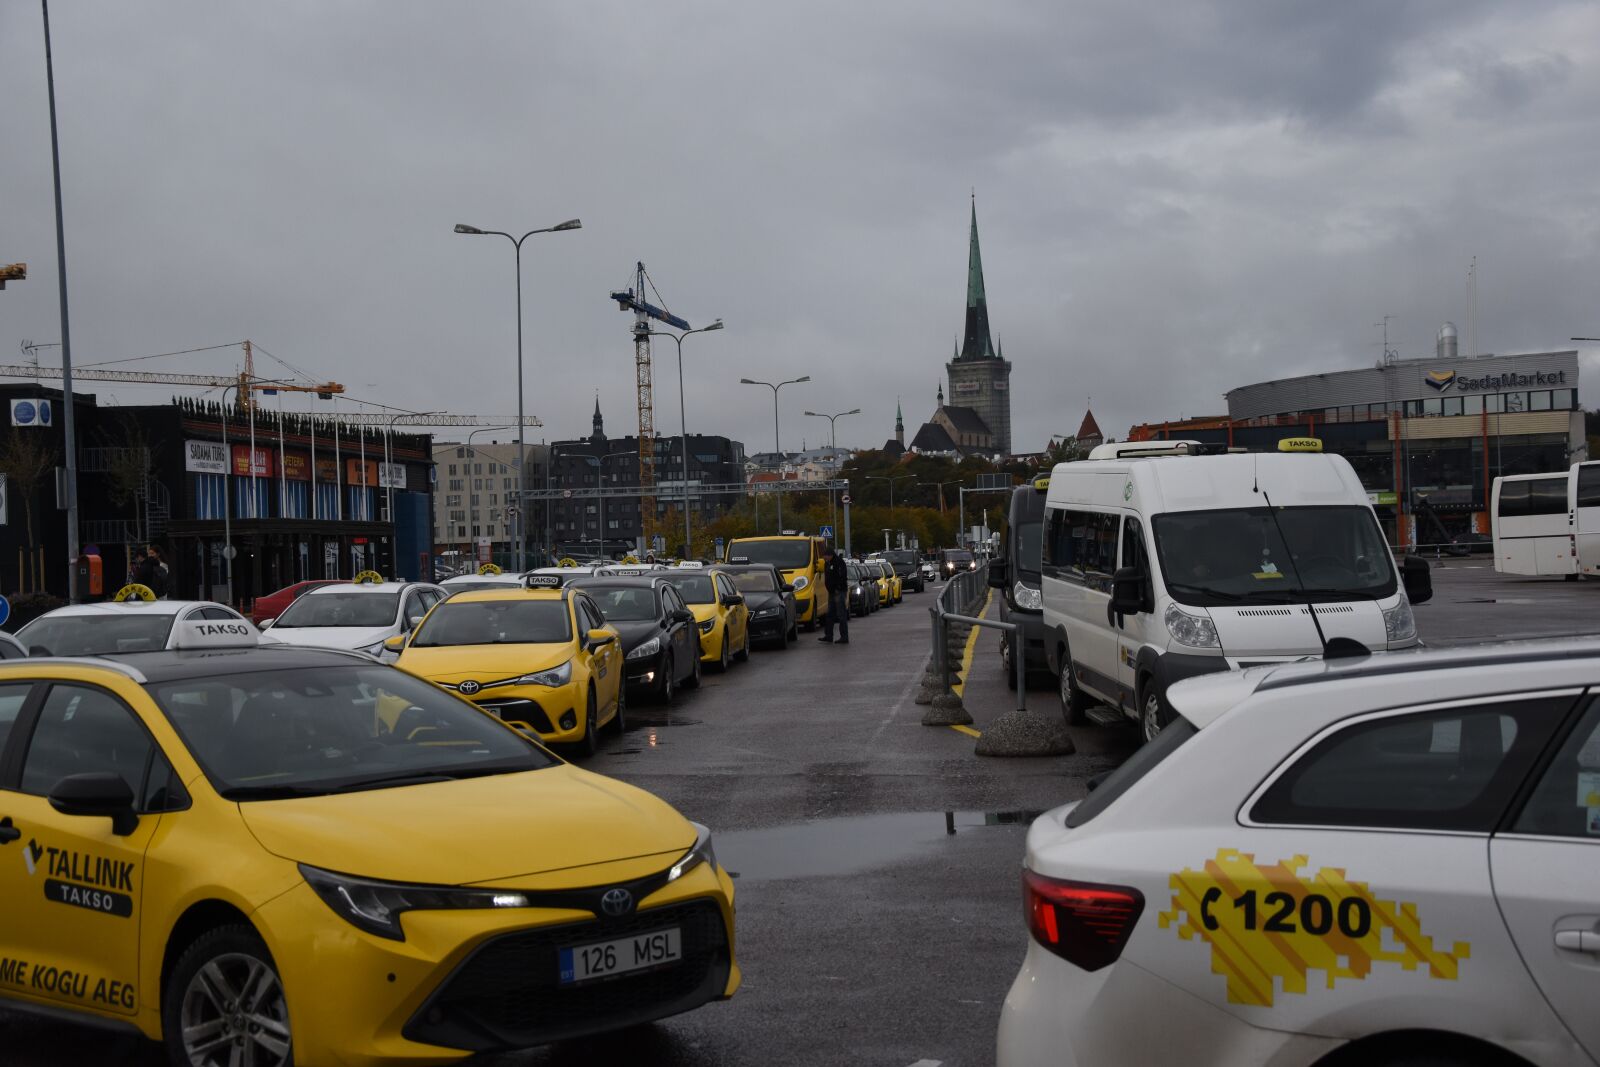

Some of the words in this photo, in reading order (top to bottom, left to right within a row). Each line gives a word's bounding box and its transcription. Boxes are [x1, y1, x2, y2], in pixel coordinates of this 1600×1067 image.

[1457, 371, 1565, 391] SadaMarket
[190, 444, 212, 461] SADAMA
[357, 572, 379, 580] TAKSO
[119, 586, 149, 598] TAKSO
[196, 624, 249, 636] TAKSO
[47, 847, 135, 892] TALLINK
[61, 885, 113, 911] TAKSO
[1234, 890, 1371, 938] 1200
[582, 945, 617, 975] 126
[634, 934, 676, 965] MSL
[0, 958, 28, 985] ME
[32, 964, 88, 998] KOGU
[93, 978, 135, 1009] AEG
